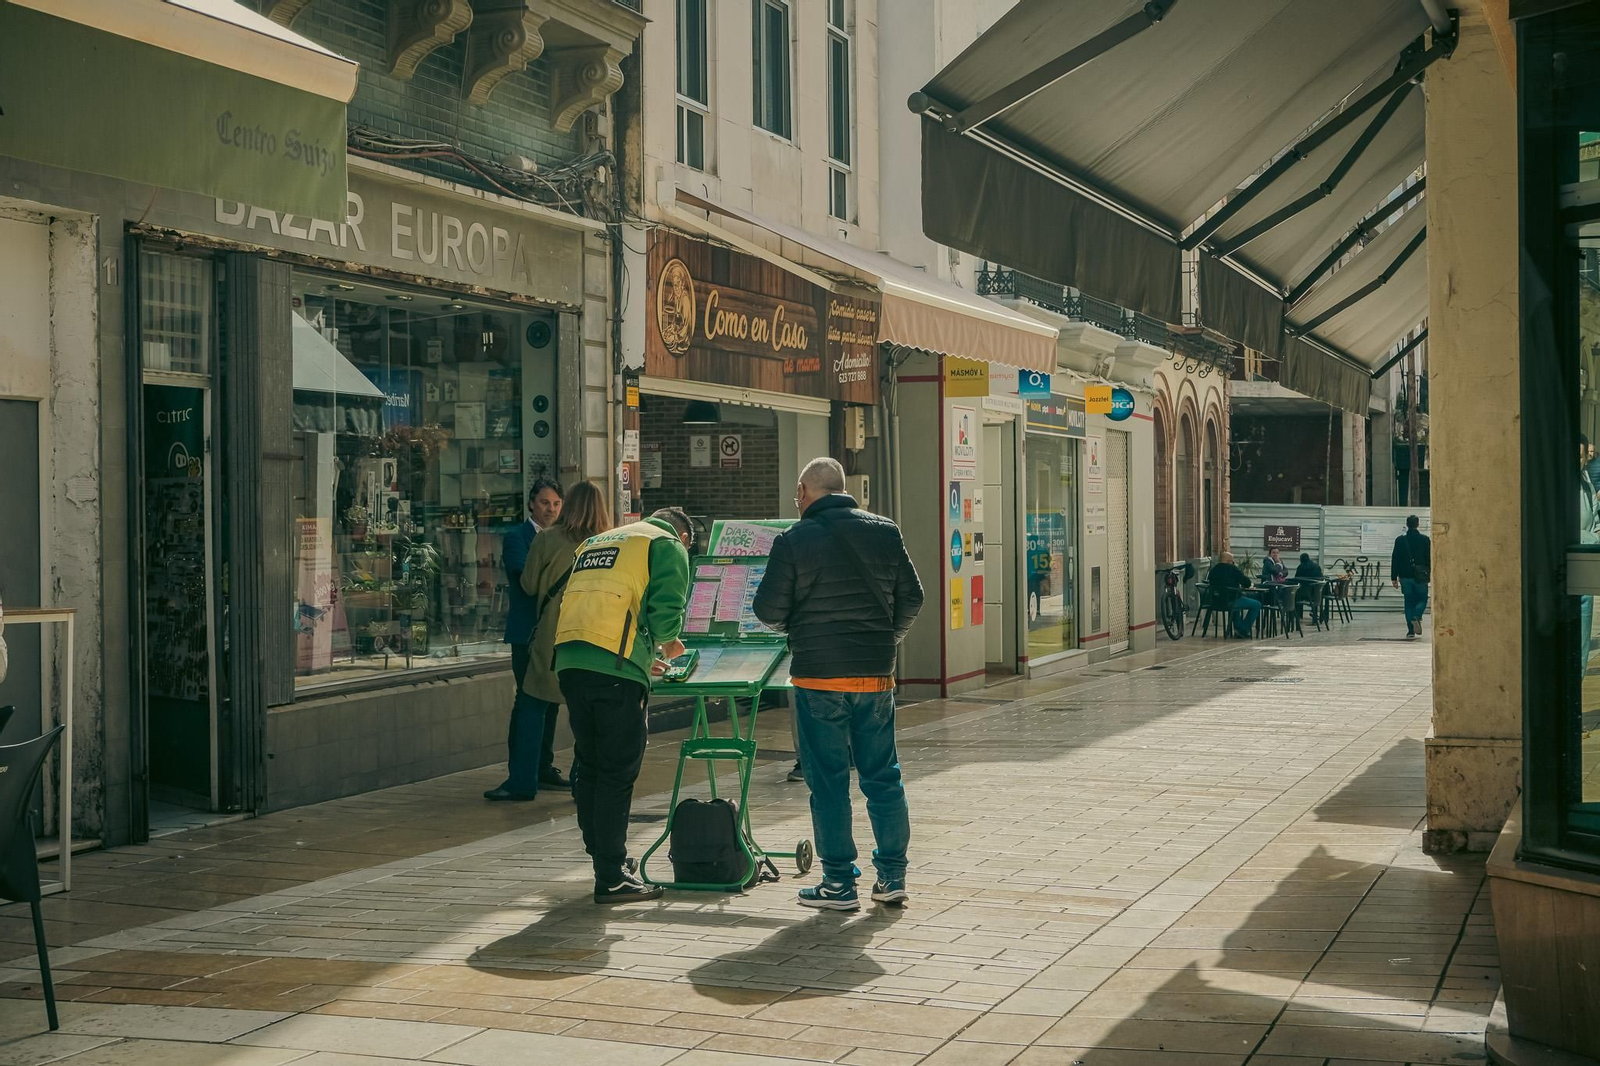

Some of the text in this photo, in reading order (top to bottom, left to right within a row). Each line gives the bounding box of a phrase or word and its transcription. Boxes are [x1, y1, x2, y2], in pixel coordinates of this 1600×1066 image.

[216, 110, 337, 177] Centro Suizo
[391, 201, 533, 286] EUROPA
[102, 257, 119, 287] 11
[704, 289, 808, 352] Como en Casa
[783, 357, 794, 374] de
[838, 373, 847, 384] 623
[848, 371, 857, 383] 727
[1029, 373, 1044, 388] O2
[597, 533, 627, 543] ONCE
[583, 556, 614, 568] ONCE
[586, 551, 602, 559] grupo
